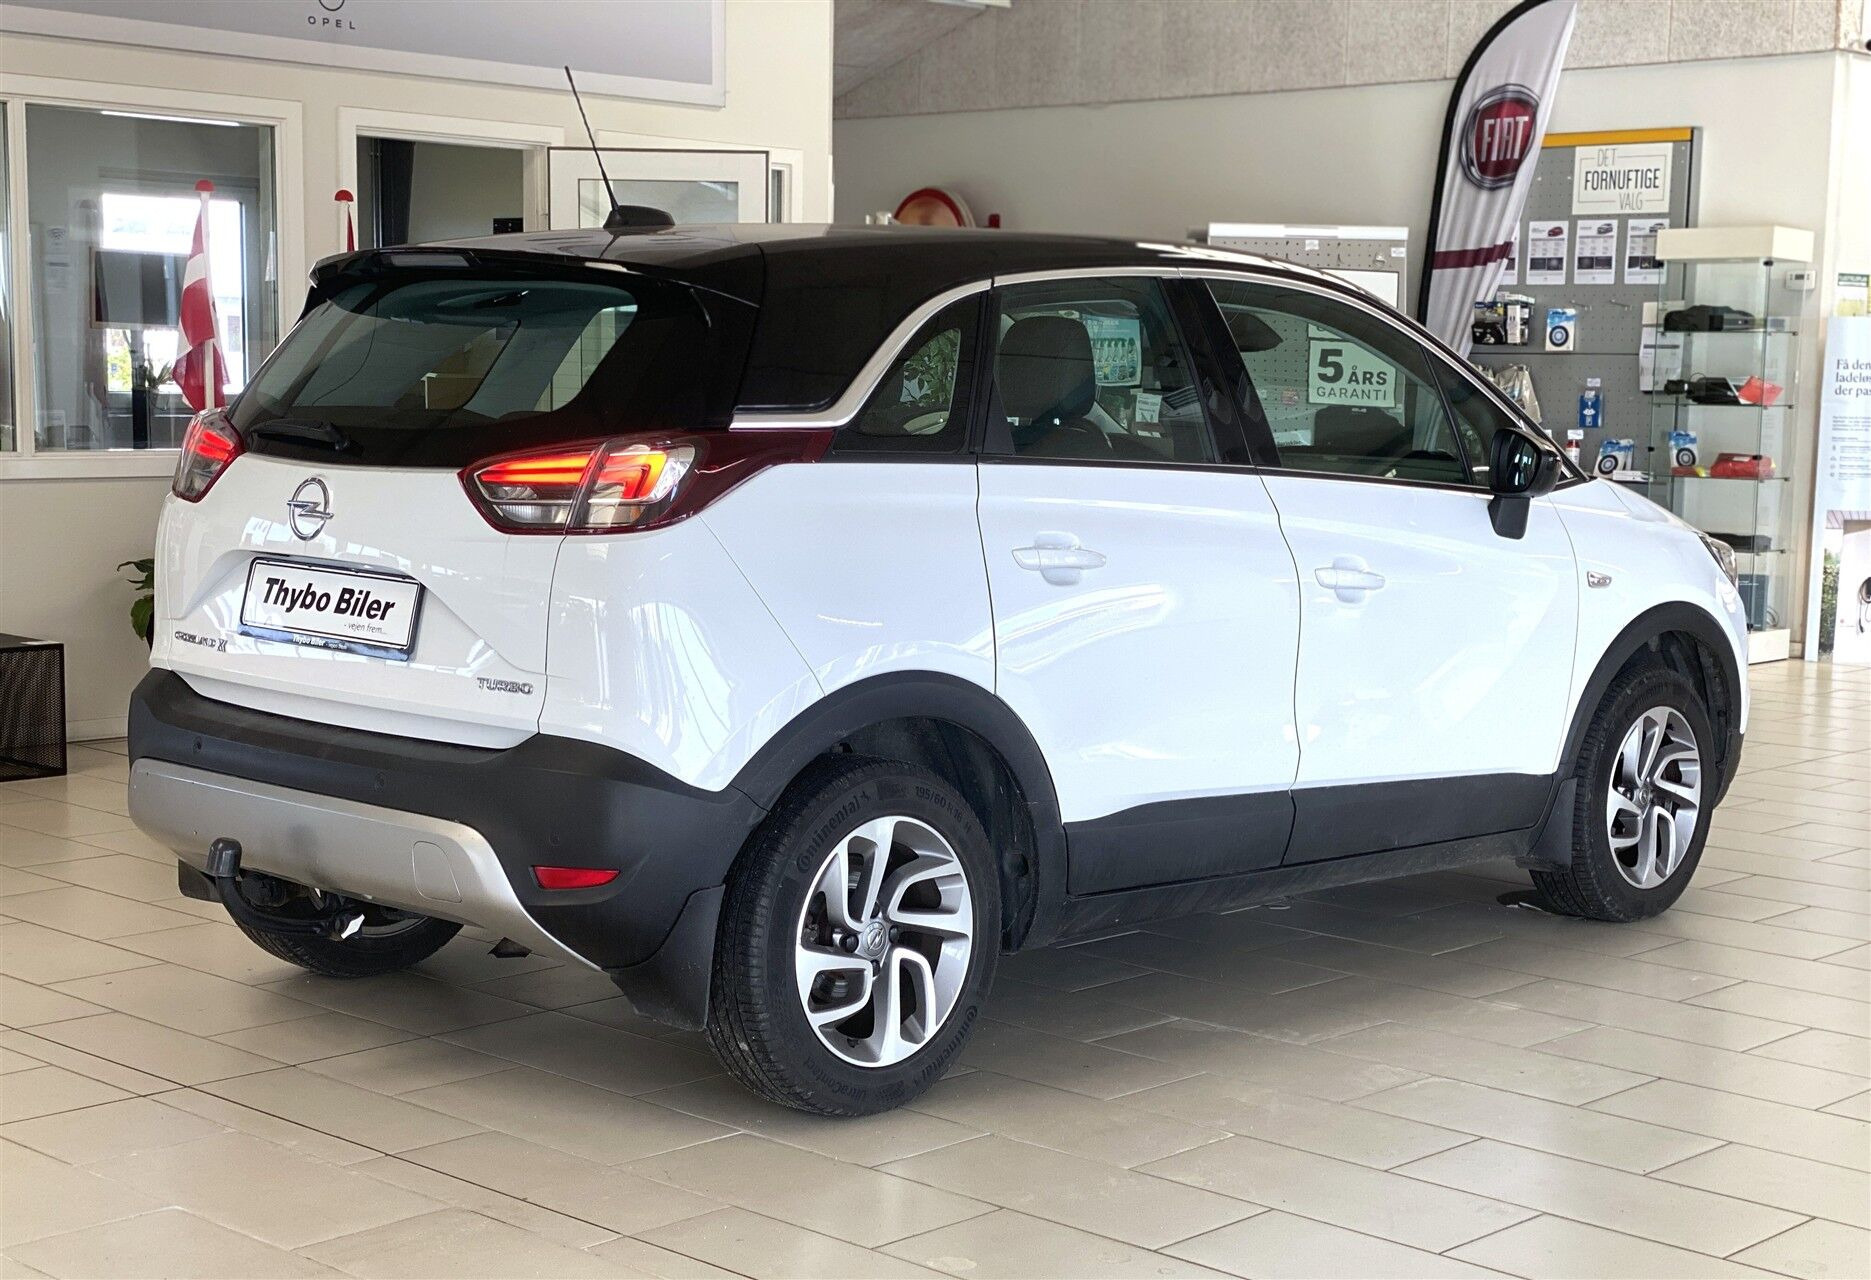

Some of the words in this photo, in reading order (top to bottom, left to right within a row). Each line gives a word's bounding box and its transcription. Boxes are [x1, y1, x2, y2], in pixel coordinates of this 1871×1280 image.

[308, 15, 356, 30] OPEL
[1481, 115, 1530, 162] FIAT
[1597, 148, 1617, 167] DET
[1584, 168, 1660, 191] FORNUFTIGE
[1618, 192, 1643, 211] VALG
[1317, 348, 1344, 384] 5
[1347, 364, 1388, 386] ÅRS
[1836, 357, 1849, 370] Få
[1316, 386, 1387, 401] GARANTI
[1834, 384, 1853, 396] der
[263, 577, 331, 613] Thybo
[333, 587, 396, 621] Biler
[476, 676, 534, 695] TURBO
[915, 785, 947, 808] 195/60
[796, 798, 862, 873] Continental
